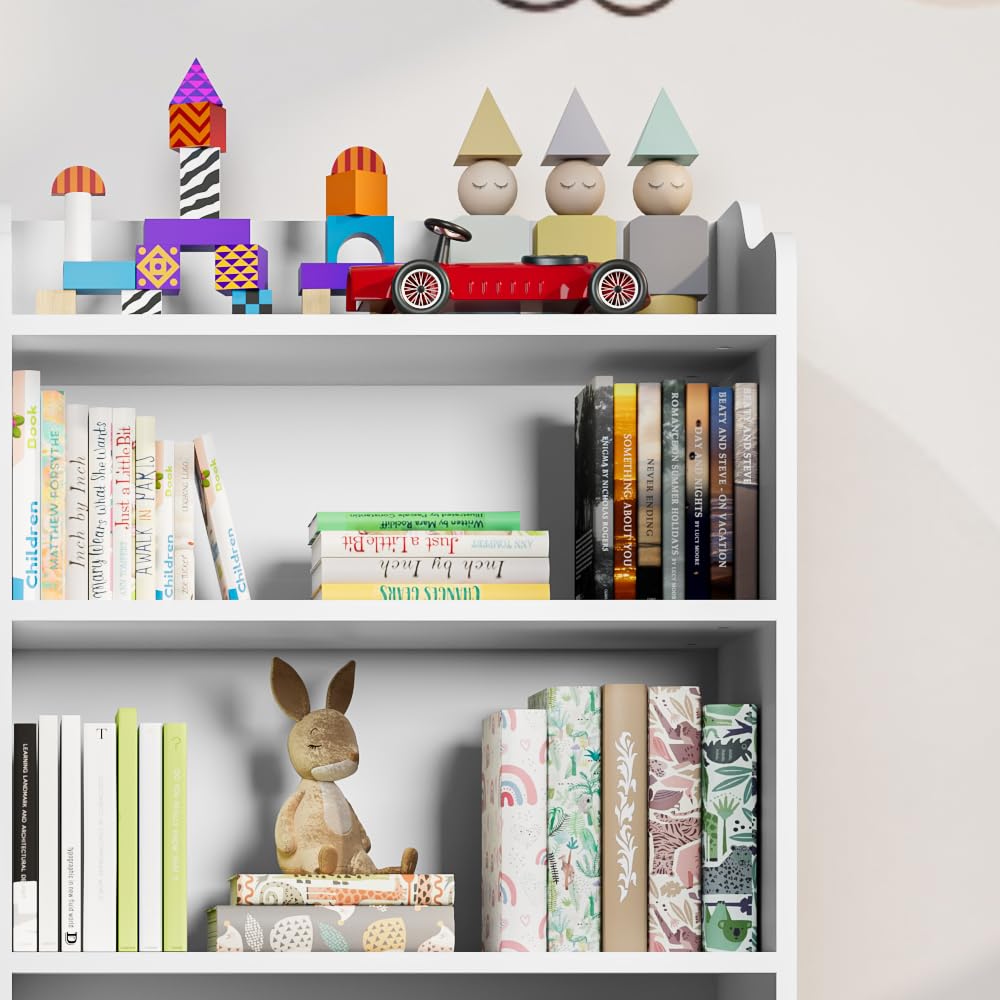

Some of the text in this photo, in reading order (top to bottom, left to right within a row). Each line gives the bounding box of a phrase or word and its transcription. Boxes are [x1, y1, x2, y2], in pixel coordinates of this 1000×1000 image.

[27, 405, 37, 449] Book
[695, 427, 703, 448] DAY
[743, 426, 752, 449] AND
[671, 448, 679, 461] ON
[743, 452, 752, 484] STEVE
[115, 426, 131, 530] Just a Little Bit
[601, 469, 609, 478] BY
[718, 392, 727, 568] BEATY AND STEVE ON VACATION
[50, 431, 59, 570] MATTHEW FORSYTHE
[68, 456, 88, 568] Inch by Inch
[140, 510, 152, 520] IN
[624, 434, 632, 567] SOMETHING ABOUT YOU
[646, 459, 654, 536] NEVER ENDING
[695, 479, 703, 518] NIGHTS
[380, 520, 484, 528] Written by Mara Rockliff
[26, 501, 38, 589] Children
[227, 528, 246, 592] Children
[343, 536, 459, 554] Just a Little Bit
[164, 534, 174, 598] Children
[380, 557, 505, 579] Inch by Inch
[96, 728, 108, 739] T
[65, 932, 77, 945] D
